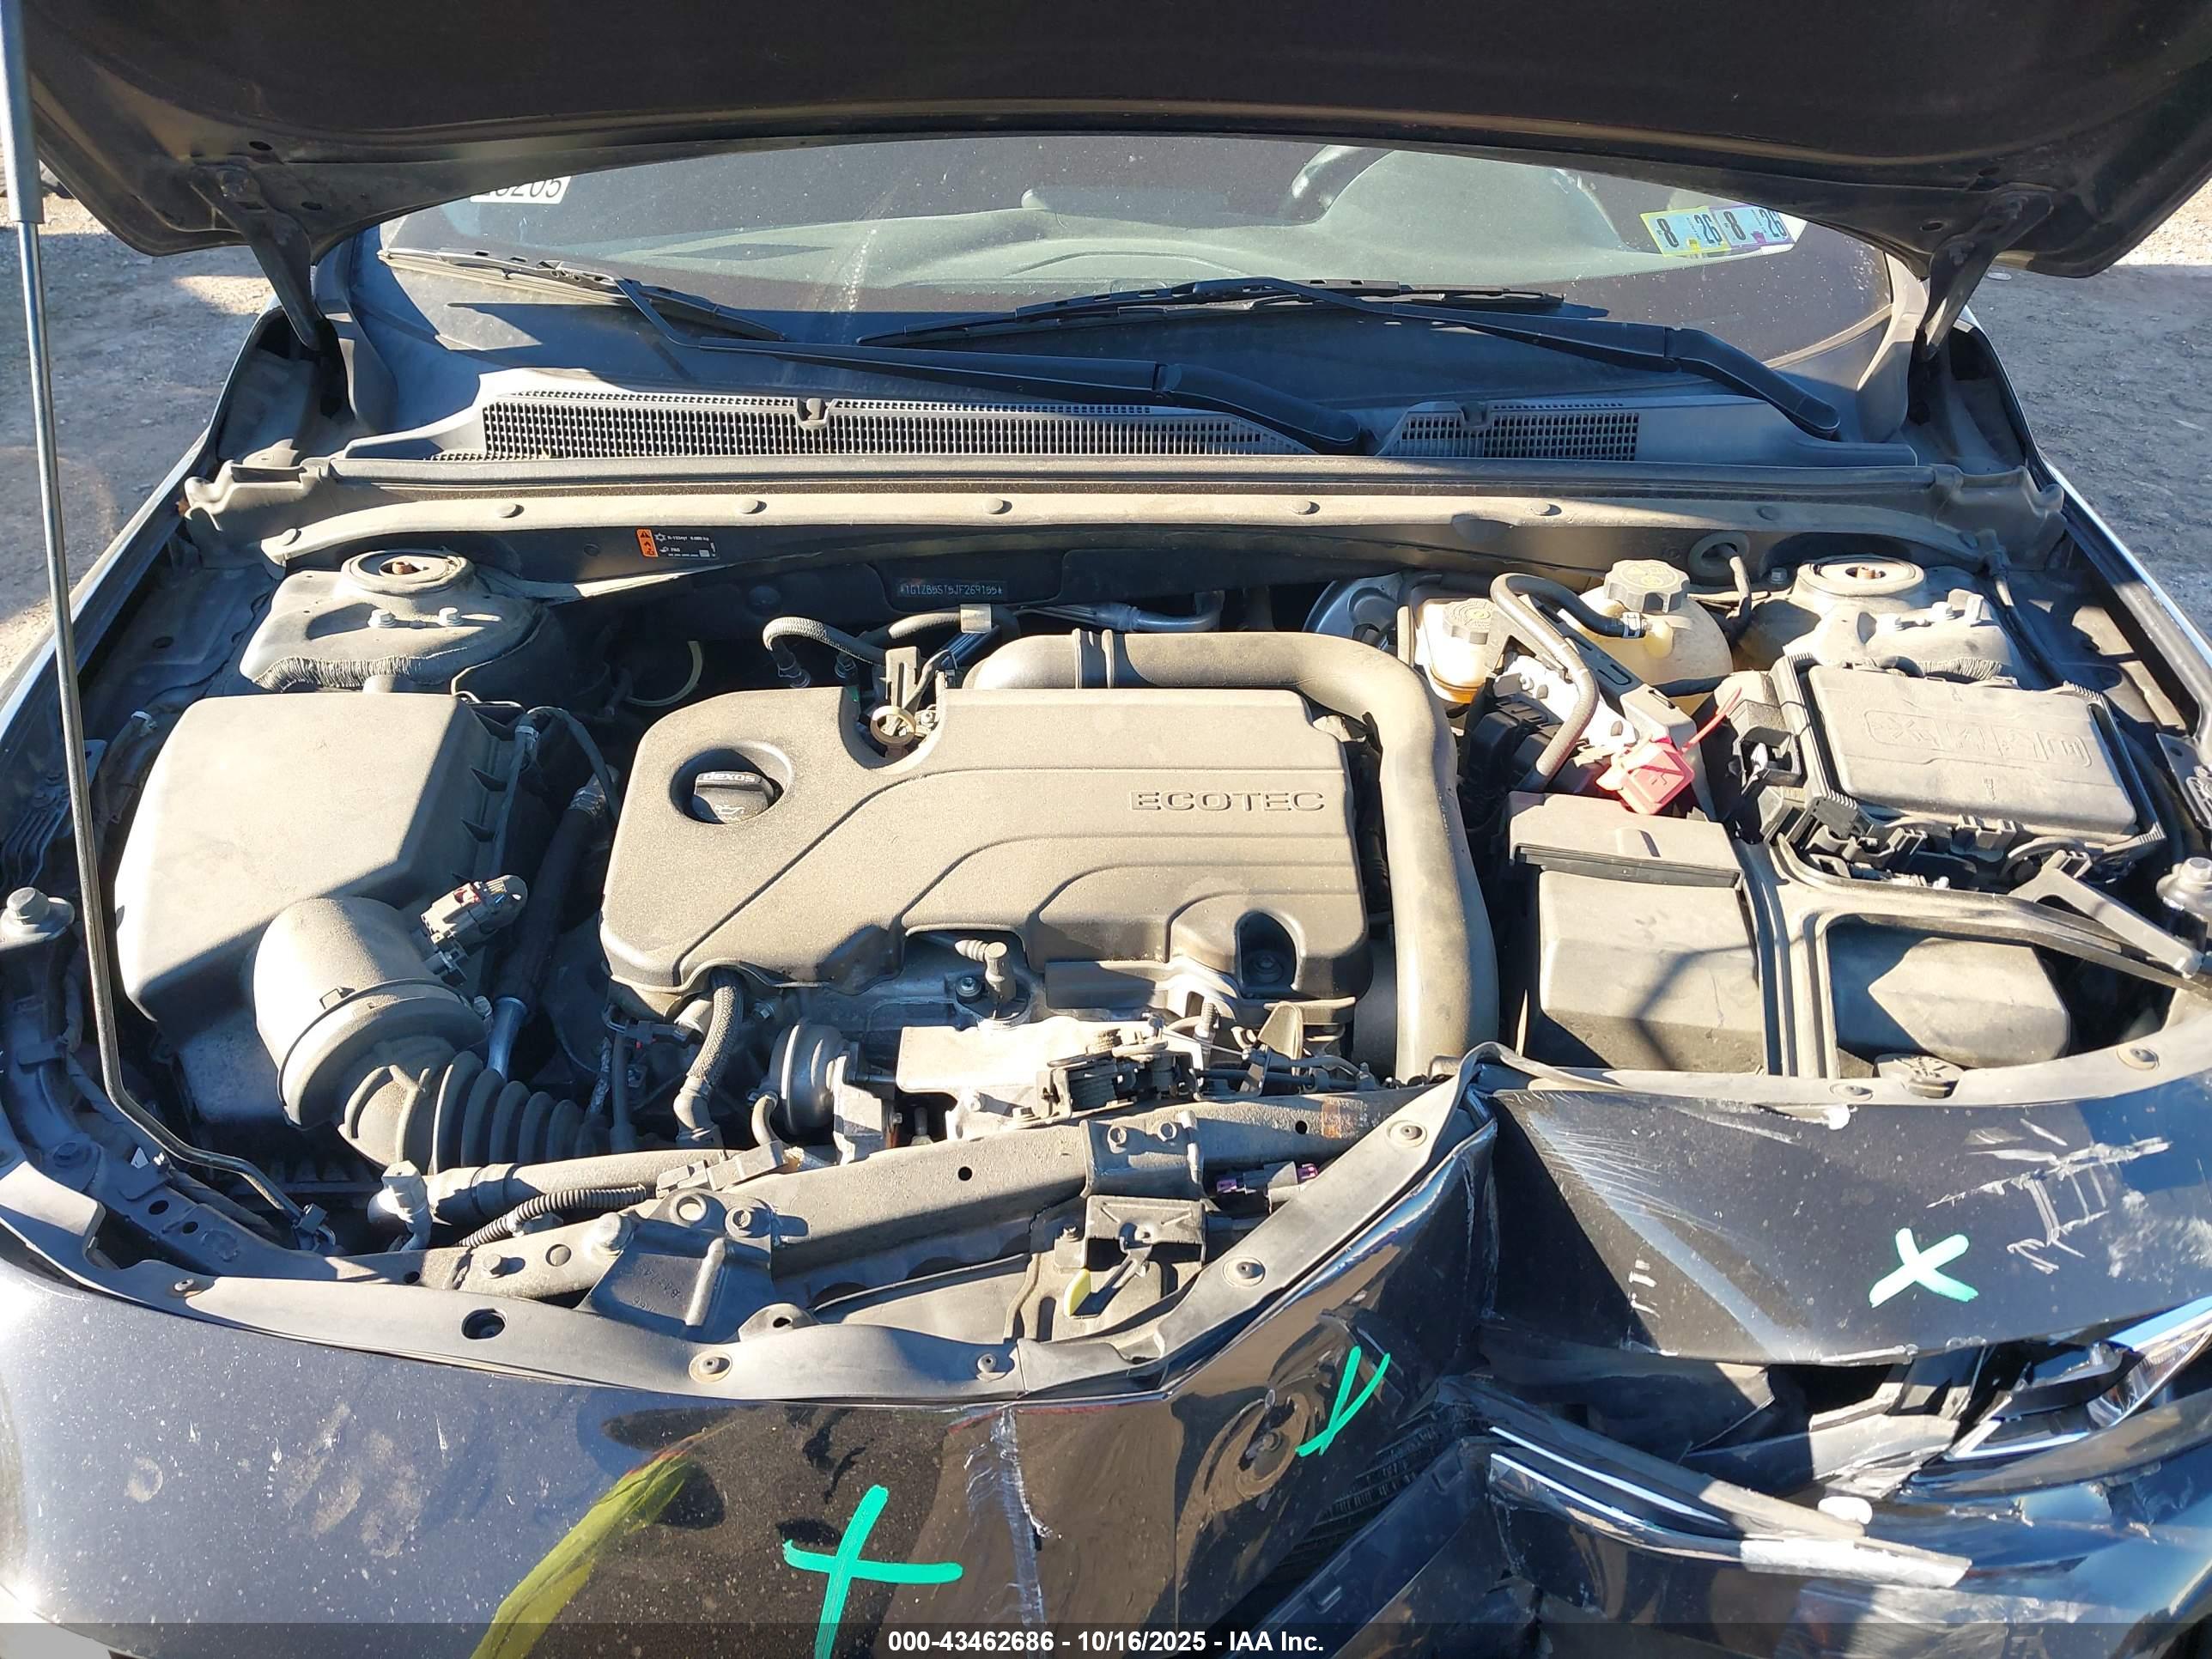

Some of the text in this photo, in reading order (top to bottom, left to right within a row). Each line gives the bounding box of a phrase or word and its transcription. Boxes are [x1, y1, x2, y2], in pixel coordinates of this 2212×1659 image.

[1656, 218, 1680, 248] 8
[1693, 214, 1723, 245] 26
[1723, 210, 1747, 241] 8
[702, 772, 757, 782] dexos
[1129, 790, 1325, 811] ECOTEC
